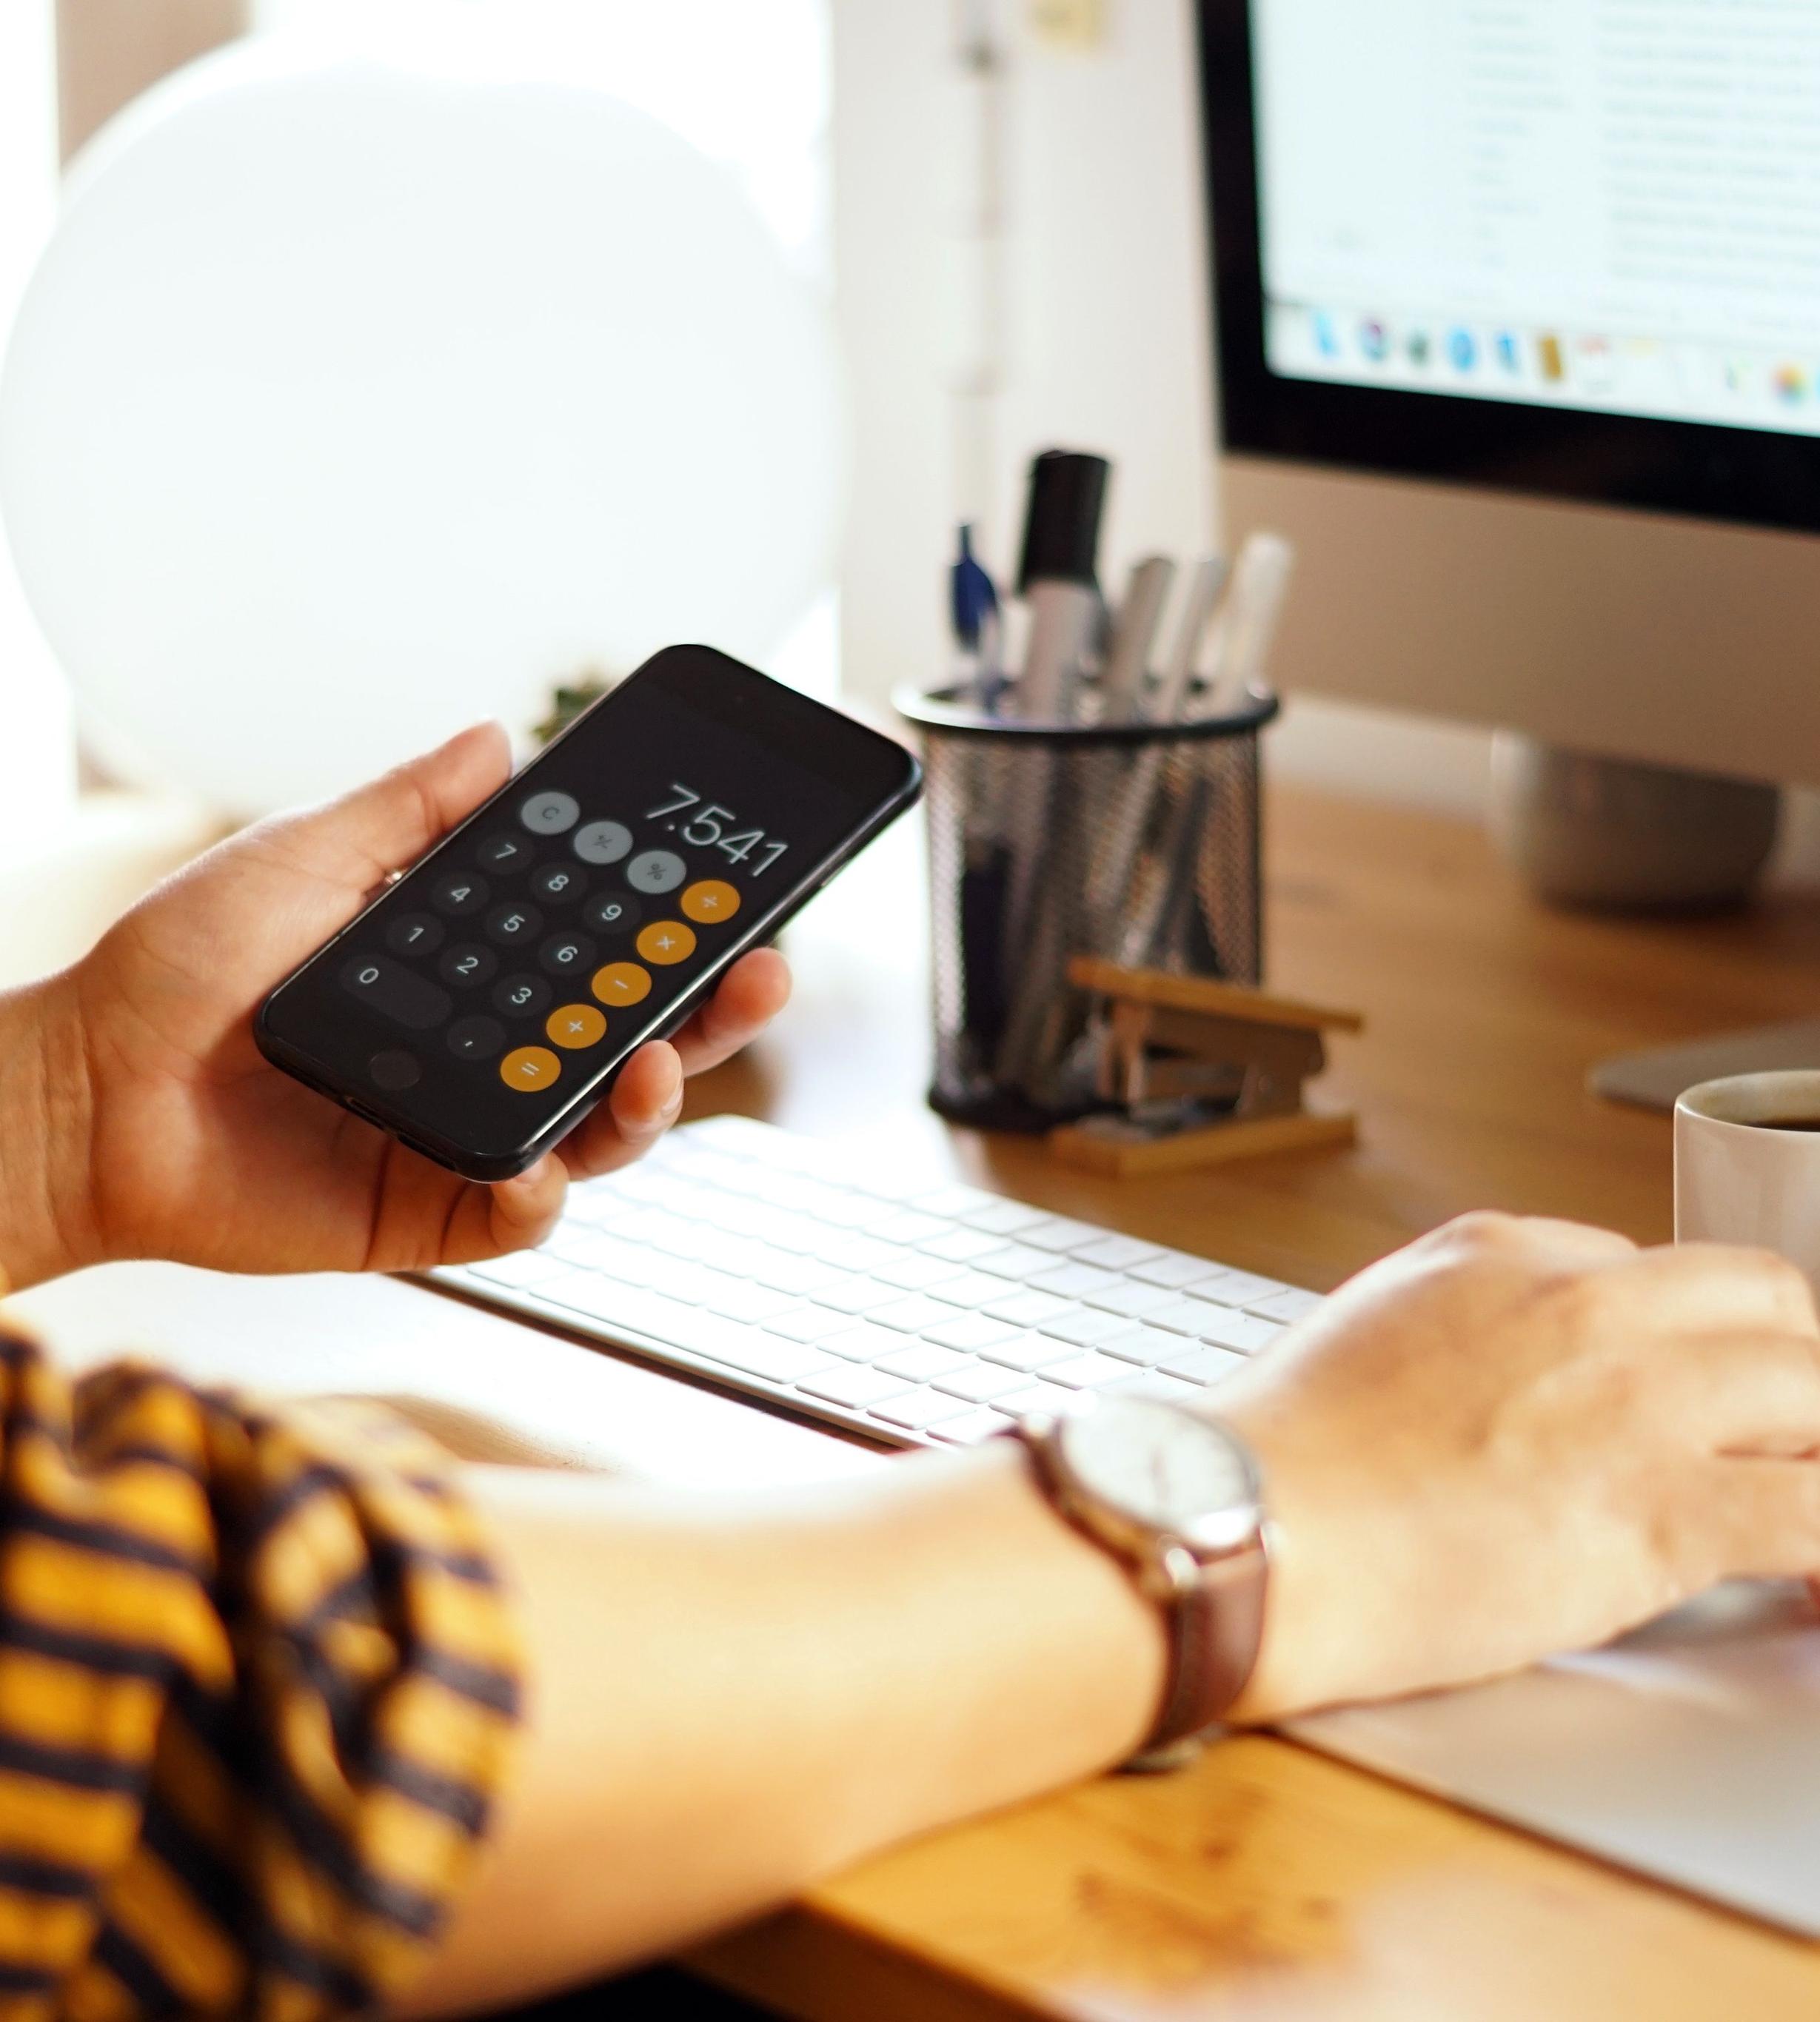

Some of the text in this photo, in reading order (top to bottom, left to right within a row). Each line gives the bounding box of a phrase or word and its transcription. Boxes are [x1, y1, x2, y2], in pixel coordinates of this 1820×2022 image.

[541, 806, 561, 820] C
[646, 783, 789, 877] 7.541
[495, 843, 518, 860] 7
[547, 874, 569, 891] 8
[601, 904, 623, 921] 9
[450, 886, 472, 903] 4
[503, 914, 525, 932] 5
[557, 945, 578, 963] 6
[358, 967, 379, 984] 0
[408, 927, 424, 943] 1
[456, 957, 479, 974] 2
[511, 987, 532, 1004] 3
